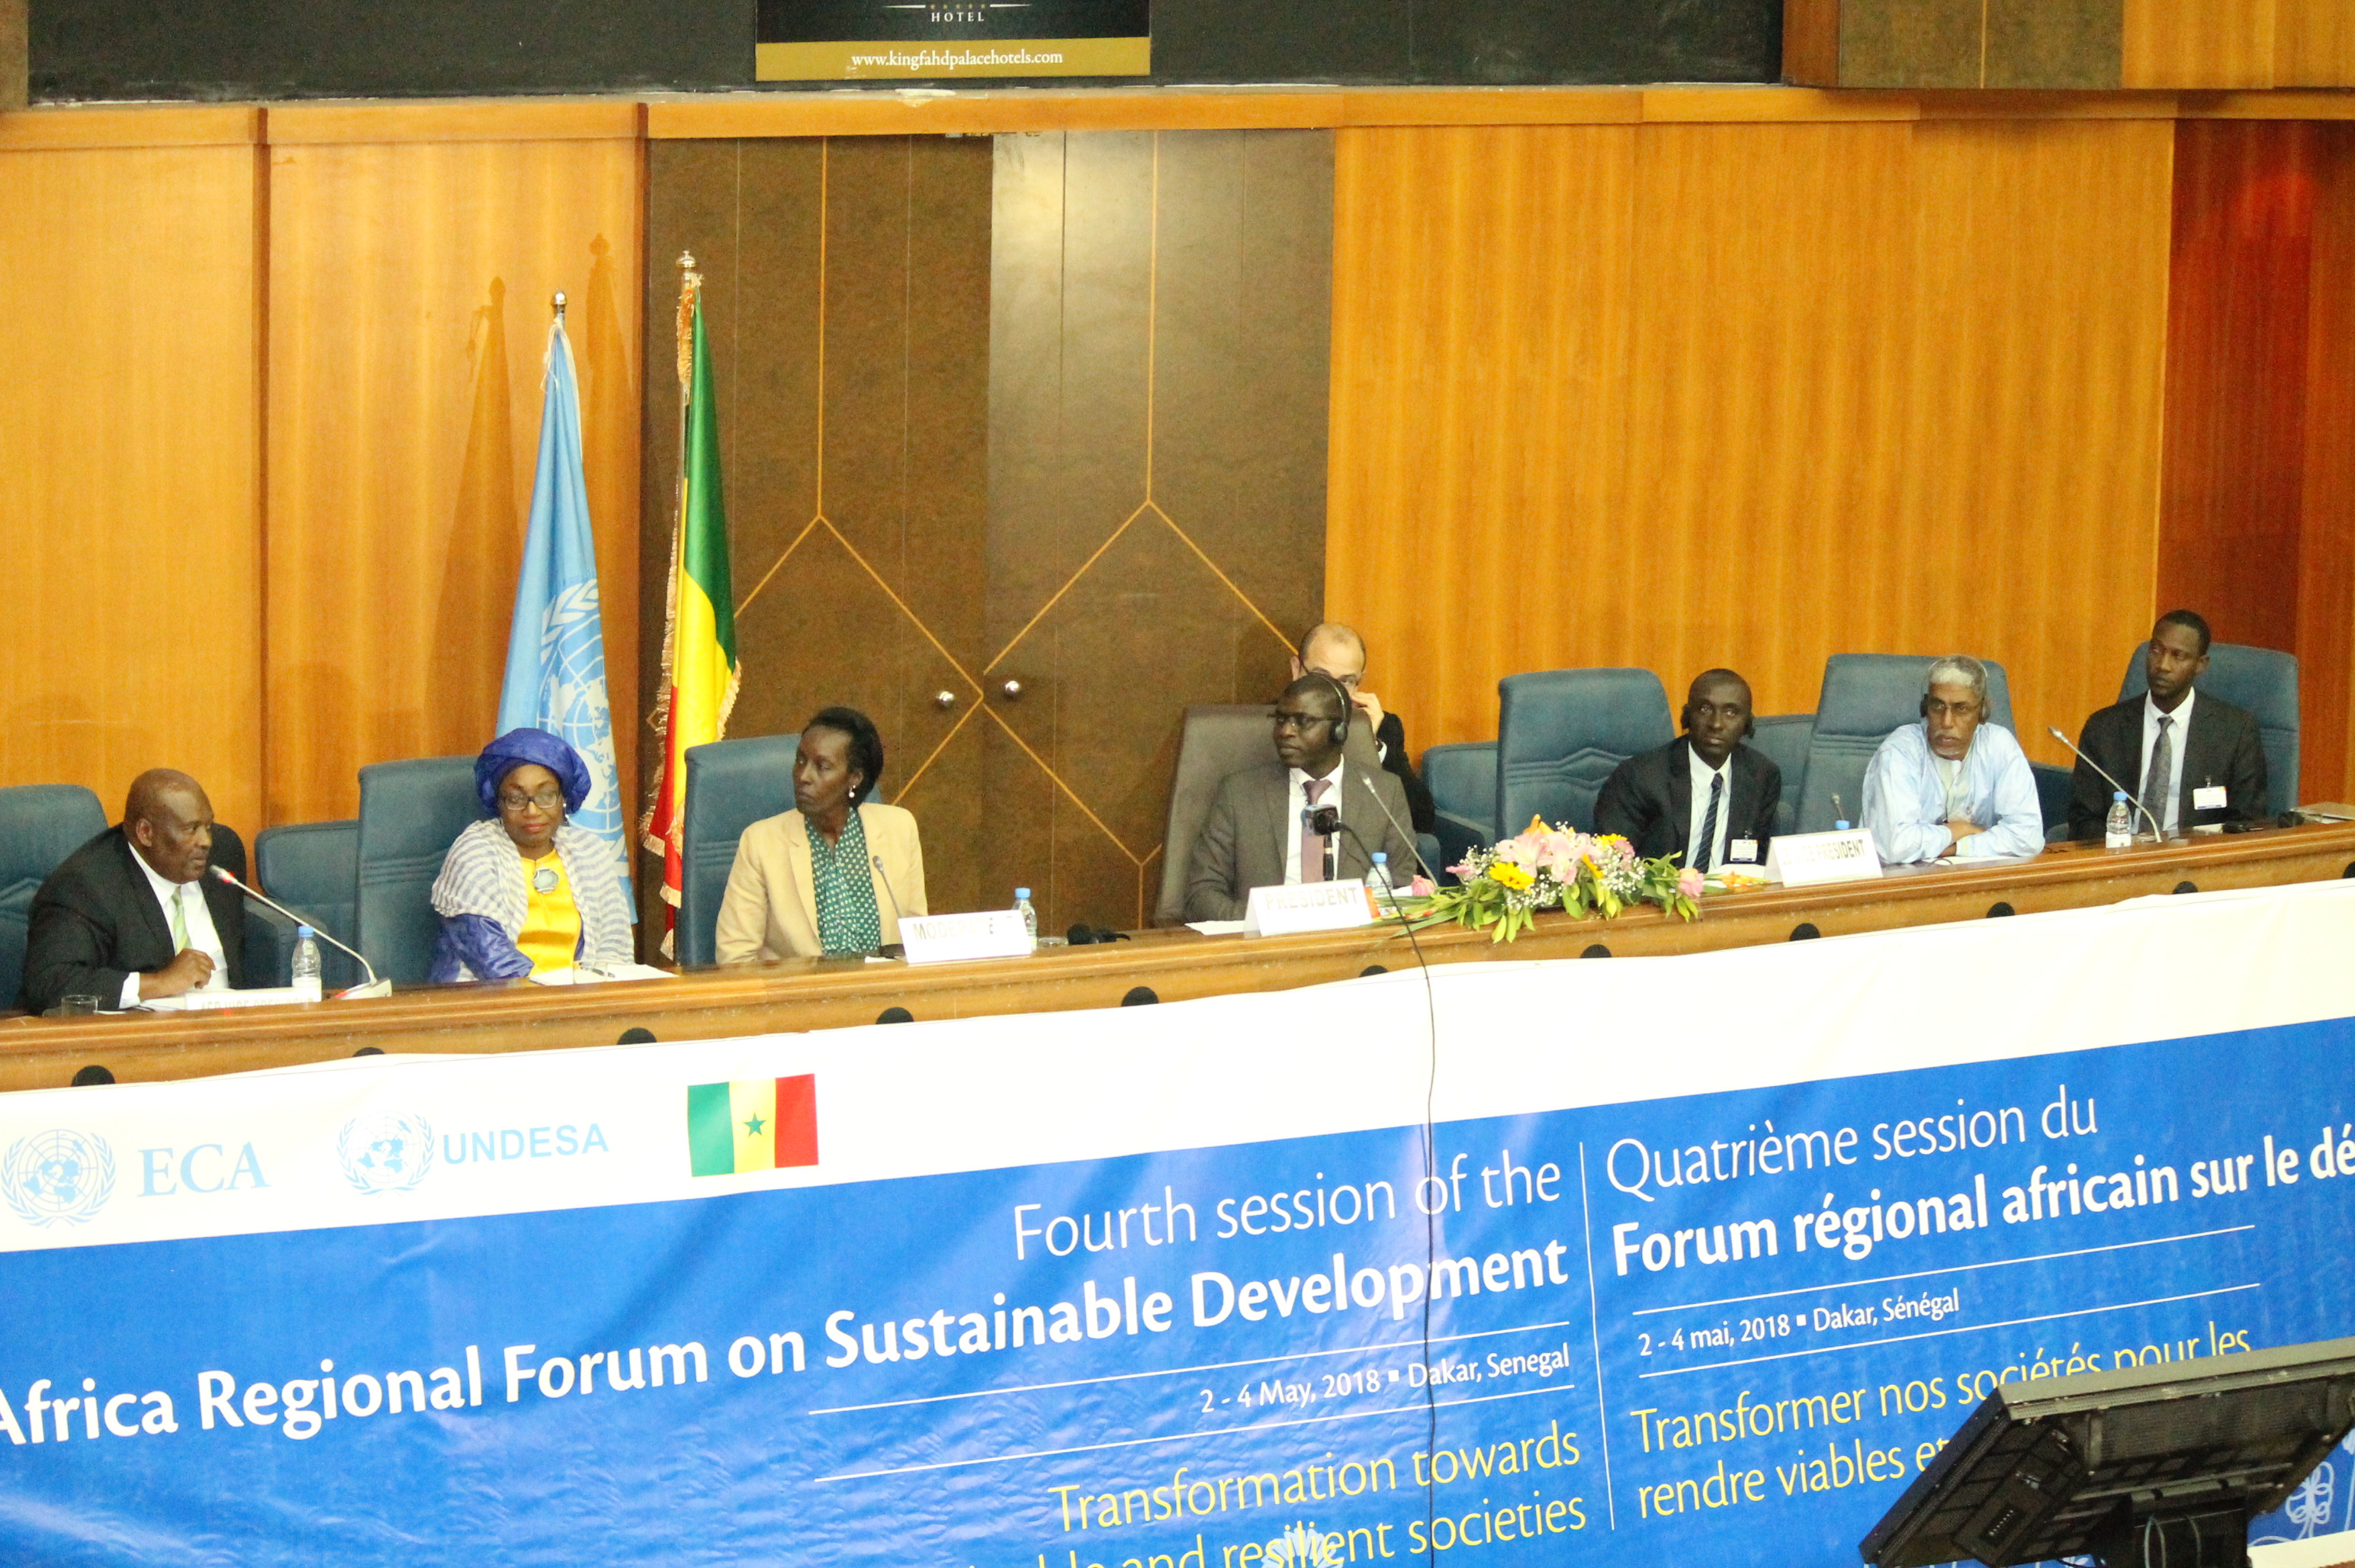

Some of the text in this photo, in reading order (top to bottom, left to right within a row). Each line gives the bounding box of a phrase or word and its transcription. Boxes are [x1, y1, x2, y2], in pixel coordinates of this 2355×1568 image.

[931, 11, 985, 23] HOTEL
[851, 49, 1064, 71] www.kingfahdpalacehotels.com
[1264, 886, 1357, 911] PRESIDENT
[138, 1143, 271, 1197] ECA
[443, 1123, 609, 1165] UNDESA
[1607, 1084, 2098, 1202] Quatrième session du
[1014, 1149, 1560, 1261] Fourth session of the
[1613, 1219, 1778, 1276] Forum
[1793, 1173, 1988, 1261] régional
[2002, 1154, 2179, 1224] africain
[2190, 1154, 2254, 1198] sur
[2263, 1135, 2299, 1187] le
[0, 1239, 1569, 1445] Africa Regional Forum on Sustainable Development
[1638, 1333, 1653, 1356] 2
[1671, 1328, 1685, 1351] 4
[1691, 1321, 1735, 1349] mai,
[1740, 1314, 1791, 1342] 2018
[1813, 1303, 1878, 1332] Dakar,
[1882, 1287, 1959, 1322] Sénégal
[1200, 1389, 1215, 1413] 2
[1237, 1383, 1256, 1408] 4
[1259, 1379, 1317, 1409] May,
[1322, 1370, 1381, 1399] 2018
[1408, 1358, 1482, 1388] Dakar,
[1486, 1342, 1569, 1378] Senegal
[1631, 1390, 1866, 1453] Transformer
[1879, 1377, 1946, 1416] nos
[2209, 1321, 2251, 1357] les
[1046, 1419, 1580, 1532] Transformation towards
[1639, 1460, 1765, 1518] rendre
[1775, 1438, 1905, 1496] viables
[1222, 1520, 1395, 1568] resilient
[1409, 1490, 1586, 1554] societies
